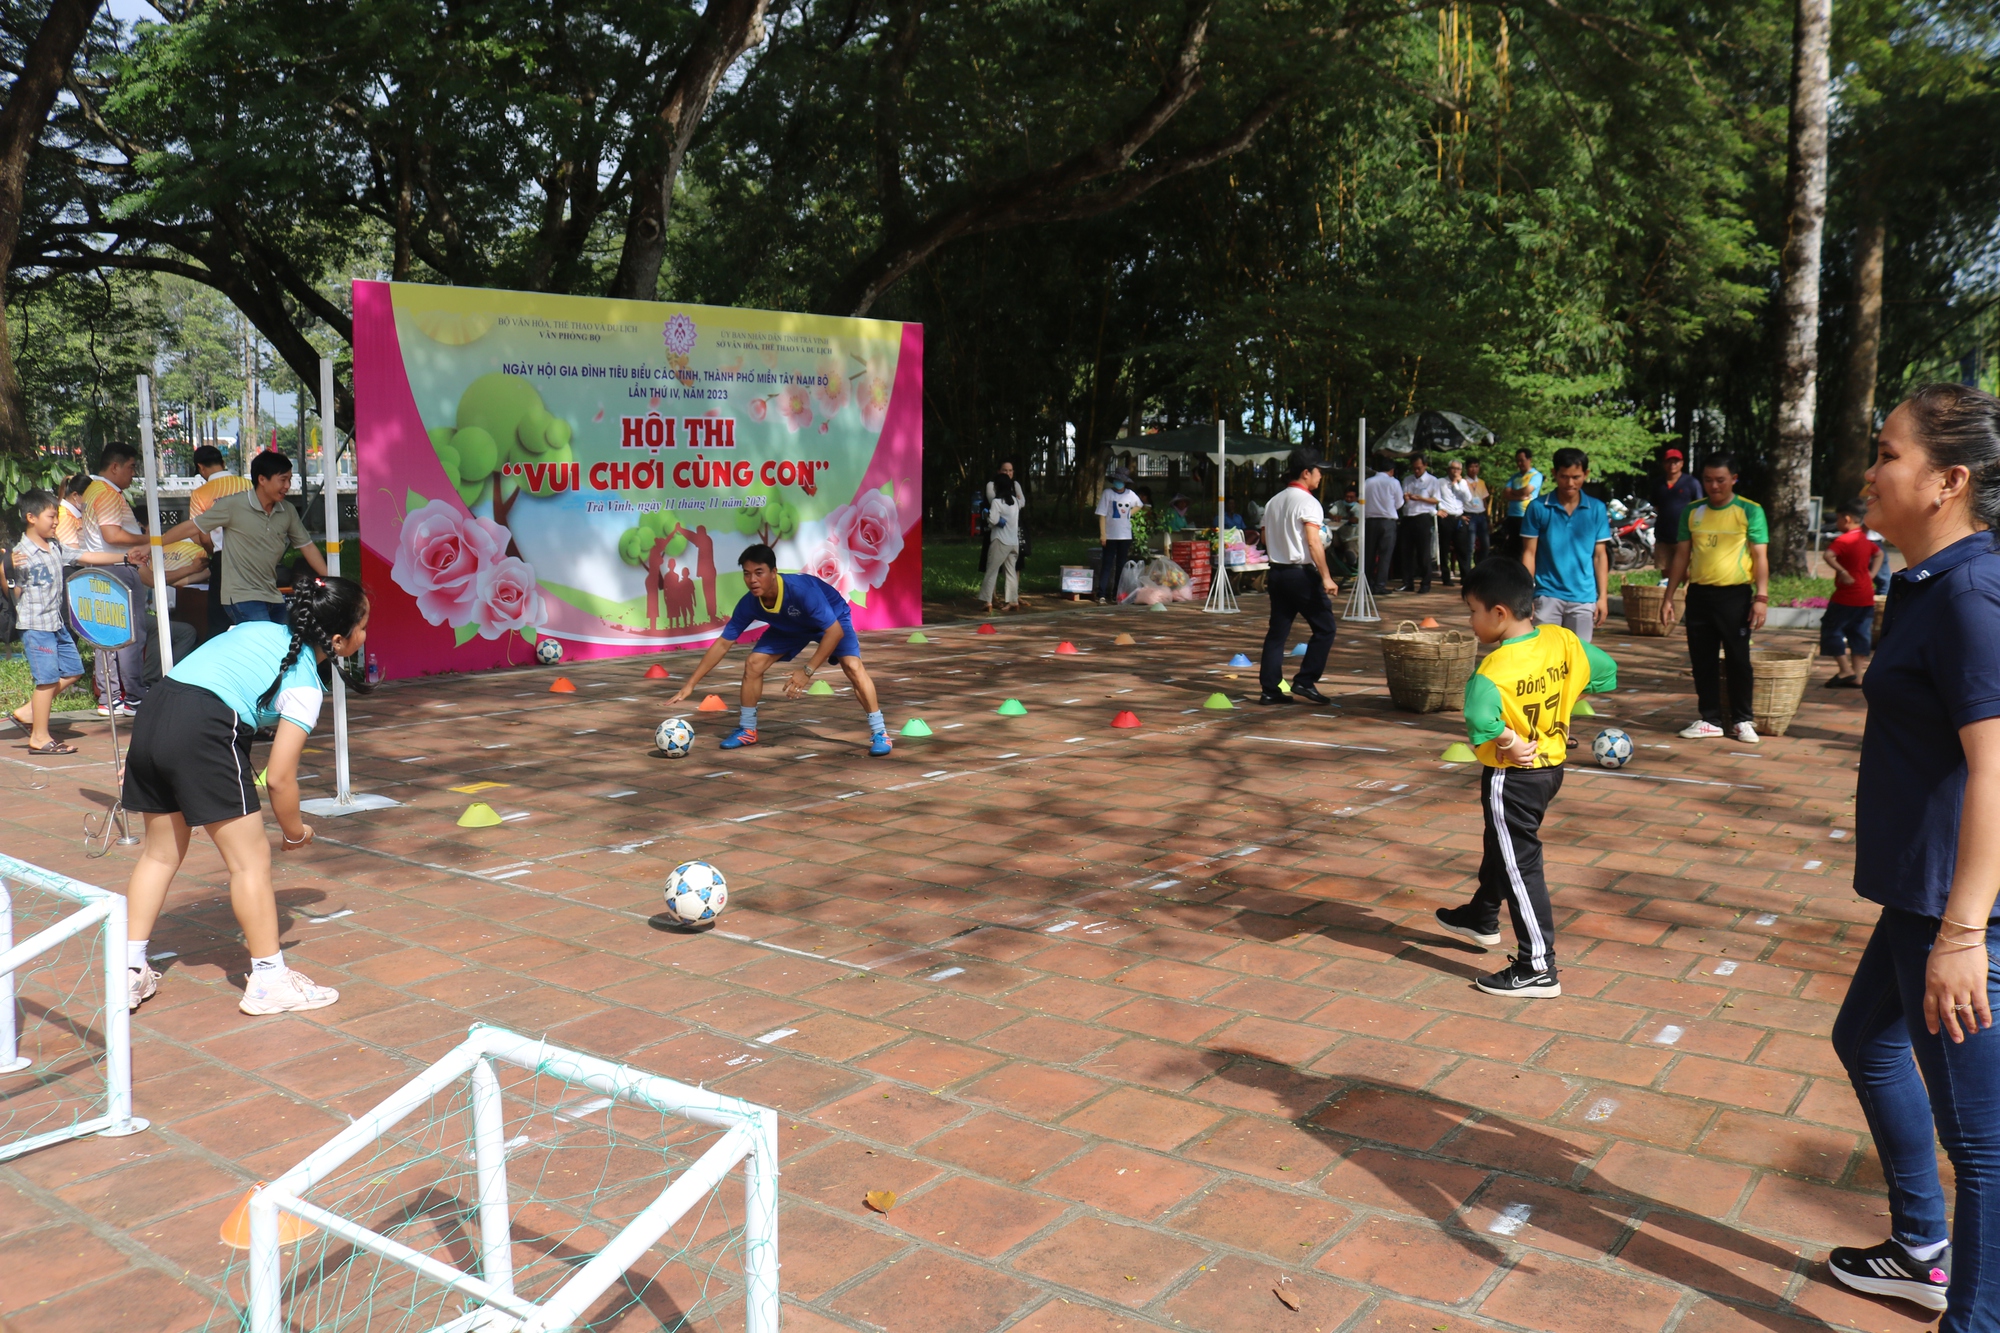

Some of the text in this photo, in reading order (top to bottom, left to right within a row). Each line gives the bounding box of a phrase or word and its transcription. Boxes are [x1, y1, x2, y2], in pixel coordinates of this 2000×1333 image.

[571, 321, 593, 331] THAO
[607, 324, 619, 332] DU
[732, 331, 747, 340] BAN
[776, 344, 796, 352] THAO
[502, 361, 534, 376] NGÀY
[537, 362, 557, 379] HỘI
[560, 365, 579, 377] GIA
[581, 364, 606, 378] ĐÌNH
[609, 365, 628, 379] TIÊU
[631, 362, 651, 380] BIỂU
[654, 366, 676, 380] CÁC
[704, 368, 735, 382] THÀNH
[736, 368, 755, 383] PHỐ
[780, 371, 794, 385] TÂY
[796, 375, 816, 386] NAM
[817, 372, 829, 388] BỘ
[628, 382, 728, 401] LẦN THỨ IV, NĂM 2023
[621, 411, 736, 453] HỘI THI
[588, 459, 664, 491] CHƠI
[672, 454, 754, 489] CÙNG
[586, 501, 604, 513] Trà
[637, 502, 662, 514] ngày
[664, 499, 675, 511] 11
[678, 498, 706, 512] tháng
[708, 497, 720, 508] 11
[721, 499, 742, 509] năm
[744, 496, 767, 508] 2023
[1706, 534, 1718, 547] 30
[89, 574, 111, 595] TỈNH
[78, 596, 126, 629] AN GIANG
[1516, 674, 1546, 697] Đồng
